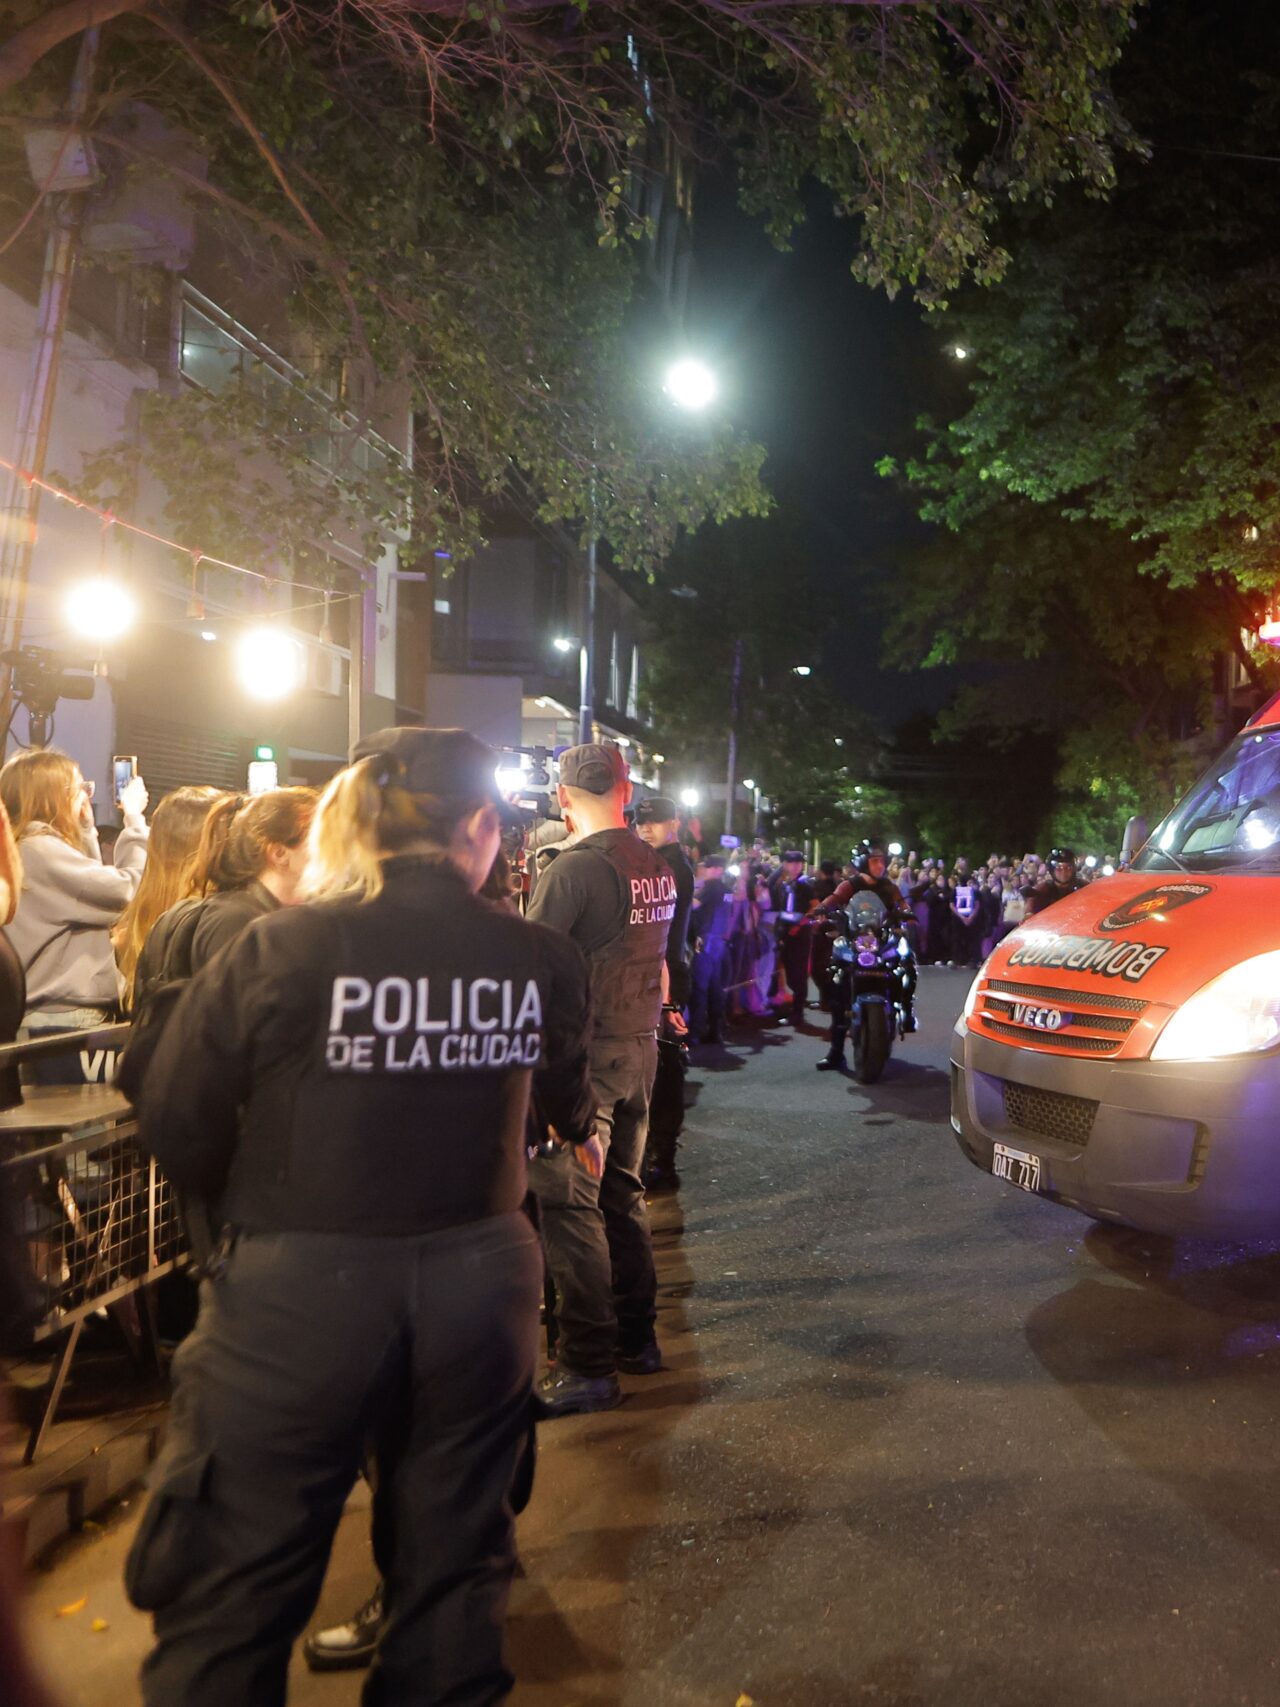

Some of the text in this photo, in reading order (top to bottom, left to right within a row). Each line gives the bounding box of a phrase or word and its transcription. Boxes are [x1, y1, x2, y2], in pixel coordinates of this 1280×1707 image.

[630, 875, 678, 905] POLICIA
[629, 909, 645, 925] DE
[646, 907, 657, 924] LA
[328, 975, 544, 1035] POLICIA
[79, 1050, 126, 1082] VI
[325, 1032, 542, 1071] DE LA CIUDAD
[1018, 1161, 1039, 1190] 717
